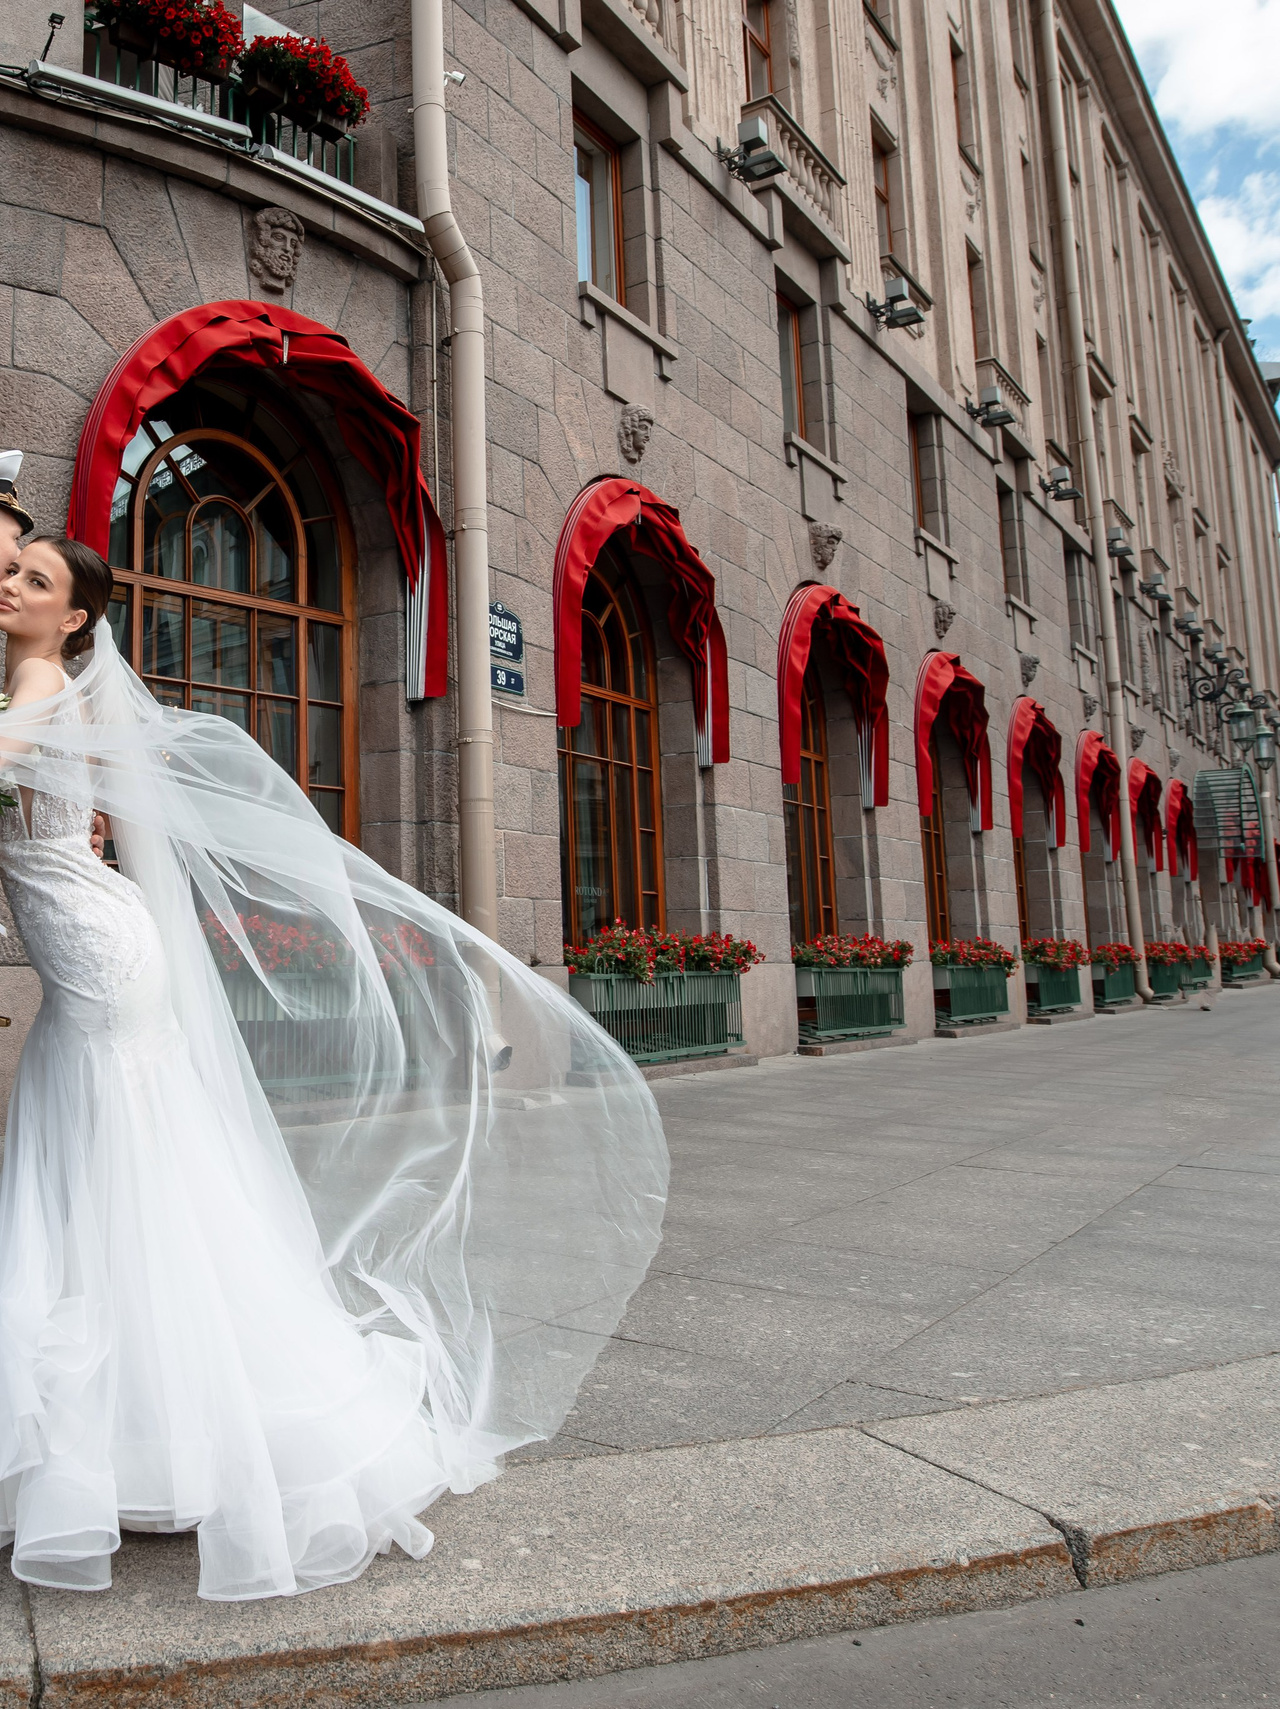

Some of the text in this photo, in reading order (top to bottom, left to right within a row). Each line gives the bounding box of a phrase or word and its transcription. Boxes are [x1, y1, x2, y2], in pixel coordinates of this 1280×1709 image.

[488, 613, 517, 633] ОЛЬШАЯ
[489, 626, 517, 645] ОРСКАЯ
[496, 669, 506, 685] 39
